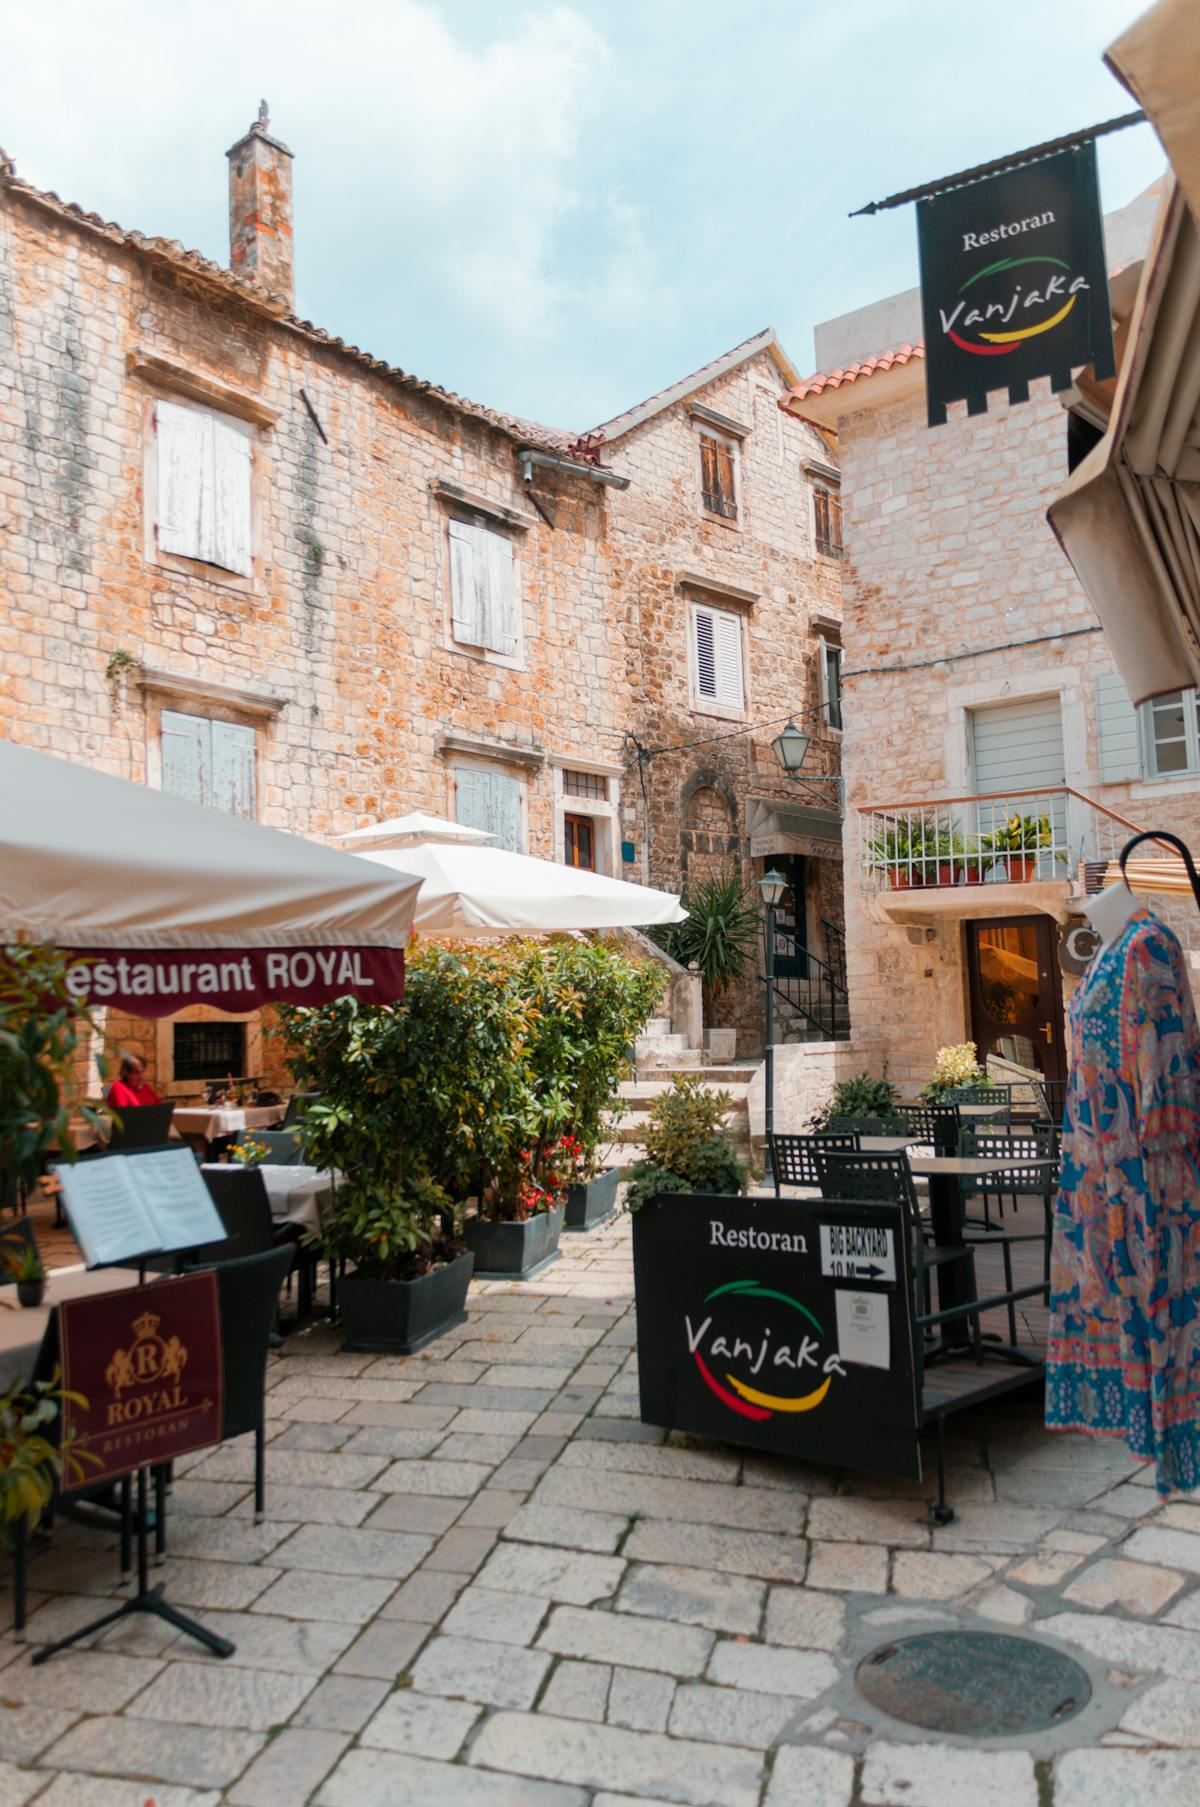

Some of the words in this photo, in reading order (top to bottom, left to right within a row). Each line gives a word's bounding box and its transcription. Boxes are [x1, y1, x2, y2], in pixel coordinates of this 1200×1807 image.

[962, 210, 1056, 251] Restoran
[939, 275, 1091, 334] Vanjaka
[64, 956, 256, 997] estaurant
[266, 951, 375, 989] ROYAL
[709, 1220, 808, 1254] Restoran
[830, 1226, 844, 1256] BIG
[846, 1227, 888, 1259] BACKYARD
[830, 1260, 843, 1277] 10
[846, 1261, 856, 1278] M
[136, 1345, 159, 1375] R
[684, 1314, 848, 1377] Vanjaka
[108, 1386, 188, 1425] ROYAL
